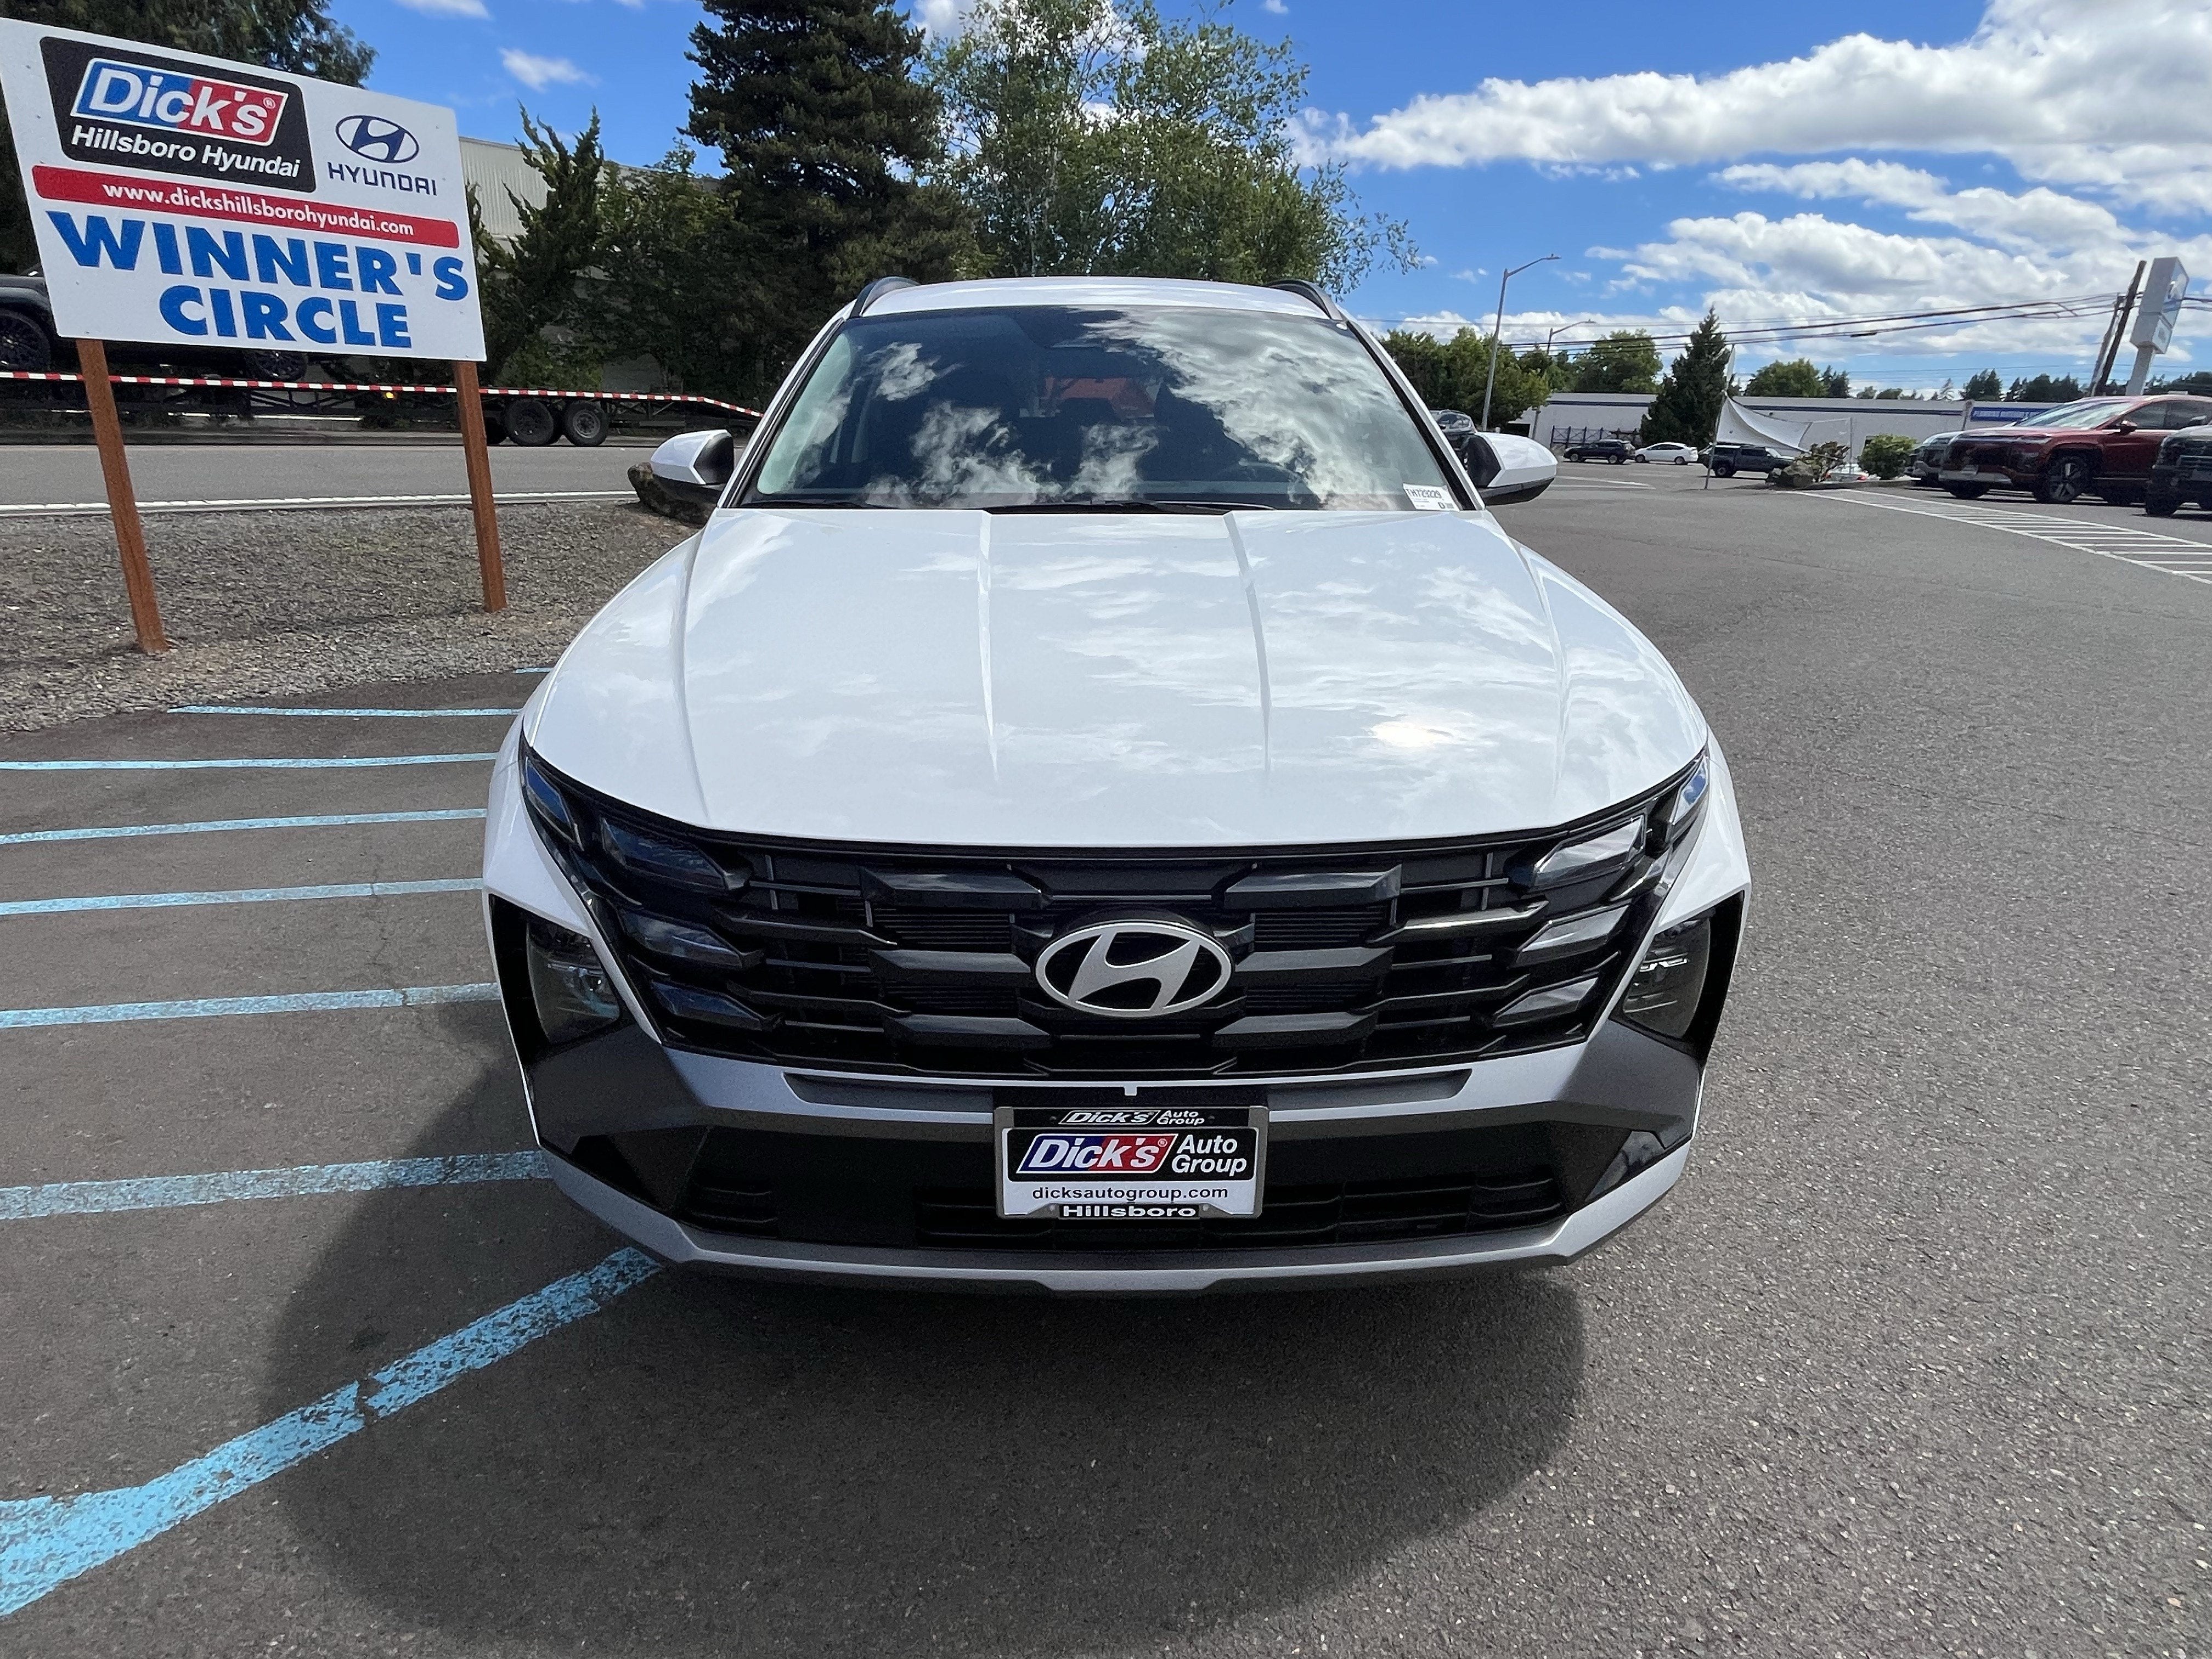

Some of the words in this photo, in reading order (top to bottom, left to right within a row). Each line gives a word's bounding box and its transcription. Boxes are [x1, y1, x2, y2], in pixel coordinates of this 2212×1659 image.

[89, 68, 269, 137] Dick's
[71, 125, 196, 162] Hillsboro
[202, 145, 300, 178] Hyundai
[328, 162, 437, 196] HYUNDAI
[102, 183, 414, 236] www.dickshillsborohyundai.com
[46, 211, 469, 301] WINNER'S
[159, 285, 413, 349] CIRCLE
[1065, 1110, 1150, 1123] Dick's
[1156, 1118, 1205, 1126] Group
[1028, 1138, 1159, 1168] Dick's
[1177, 1135, 1238, 1154] Auto
[1171, 1155, 1246, 1176] Group
[1032, 1187, 1228, 1201] dicksautogroup.com
[1063, 1206, 1196, 1217] Hillsboro
